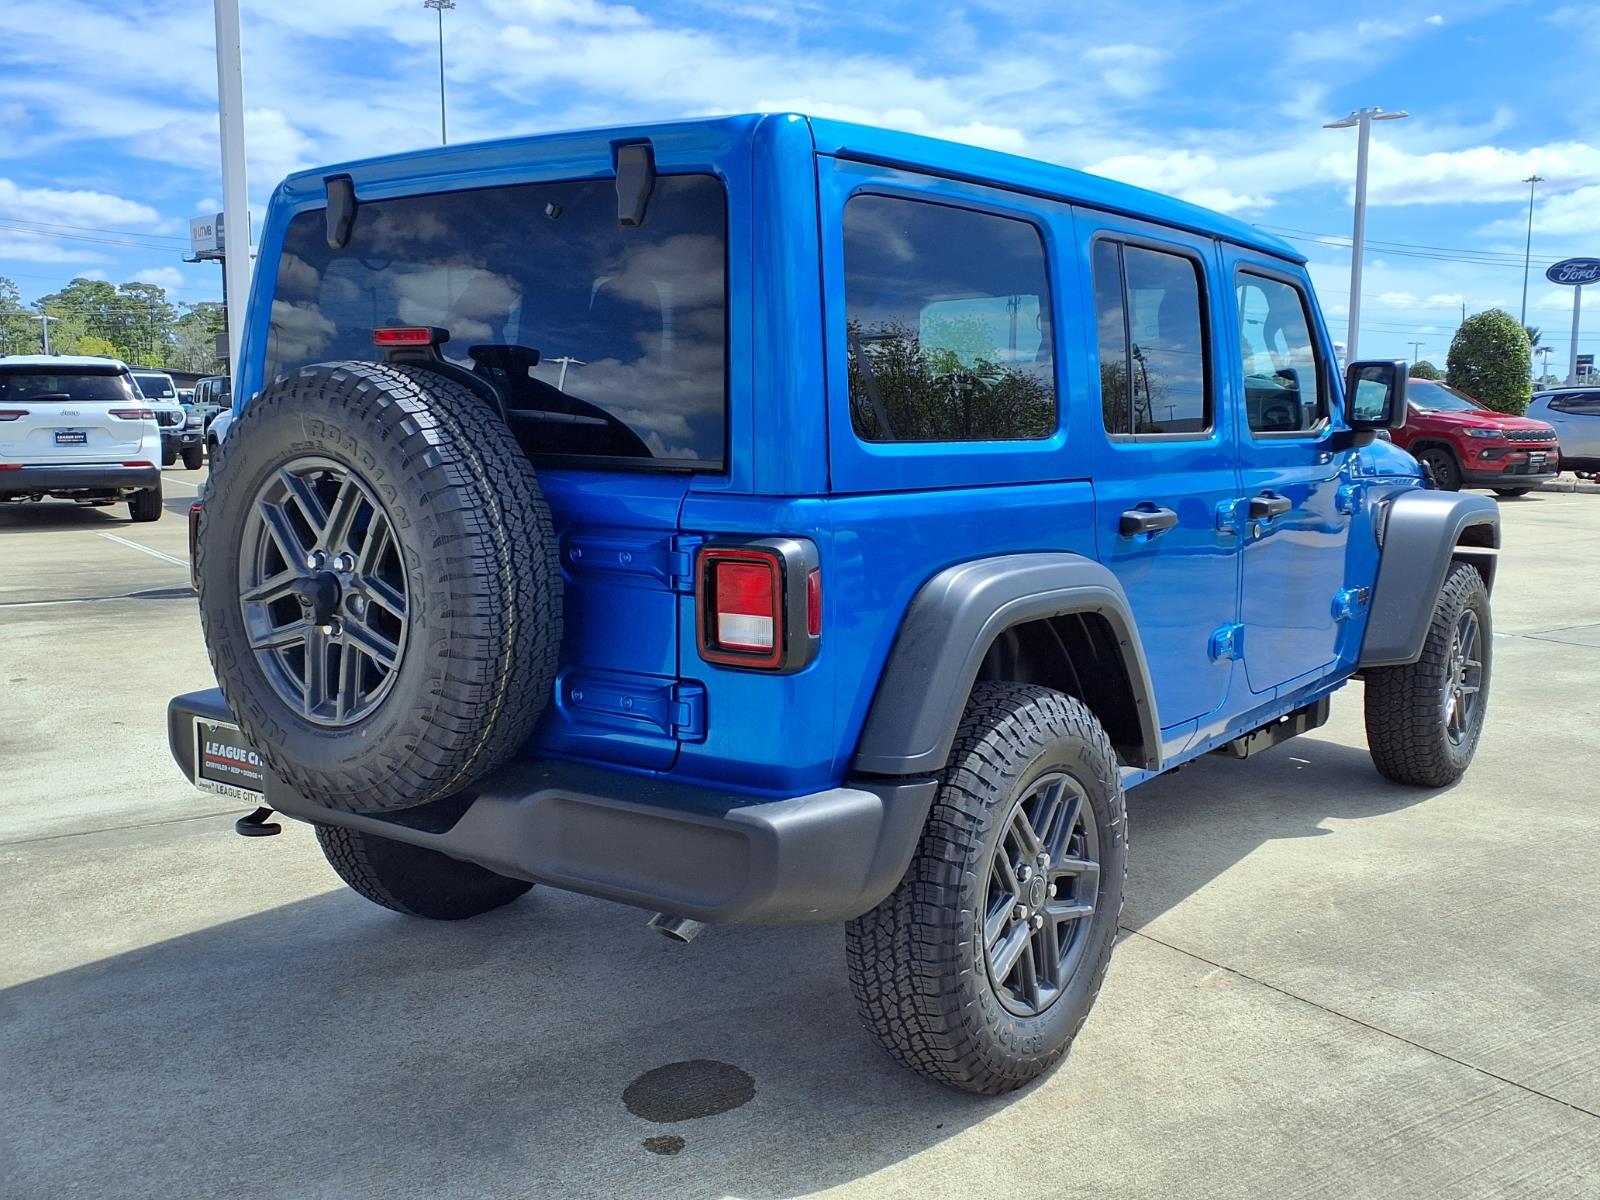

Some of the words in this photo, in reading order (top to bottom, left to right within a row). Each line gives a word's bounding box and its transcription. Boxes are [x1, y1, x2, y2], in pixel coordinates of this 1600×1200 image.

[1559, 263, 1599, 281] Ford
[205, 741, 247, 762] LEAGUE
[205, 760, 228, 772] CHRYSLER
[216, 784, 242, 799] LEAGUE
[243, 791, 258, 803] CITY
